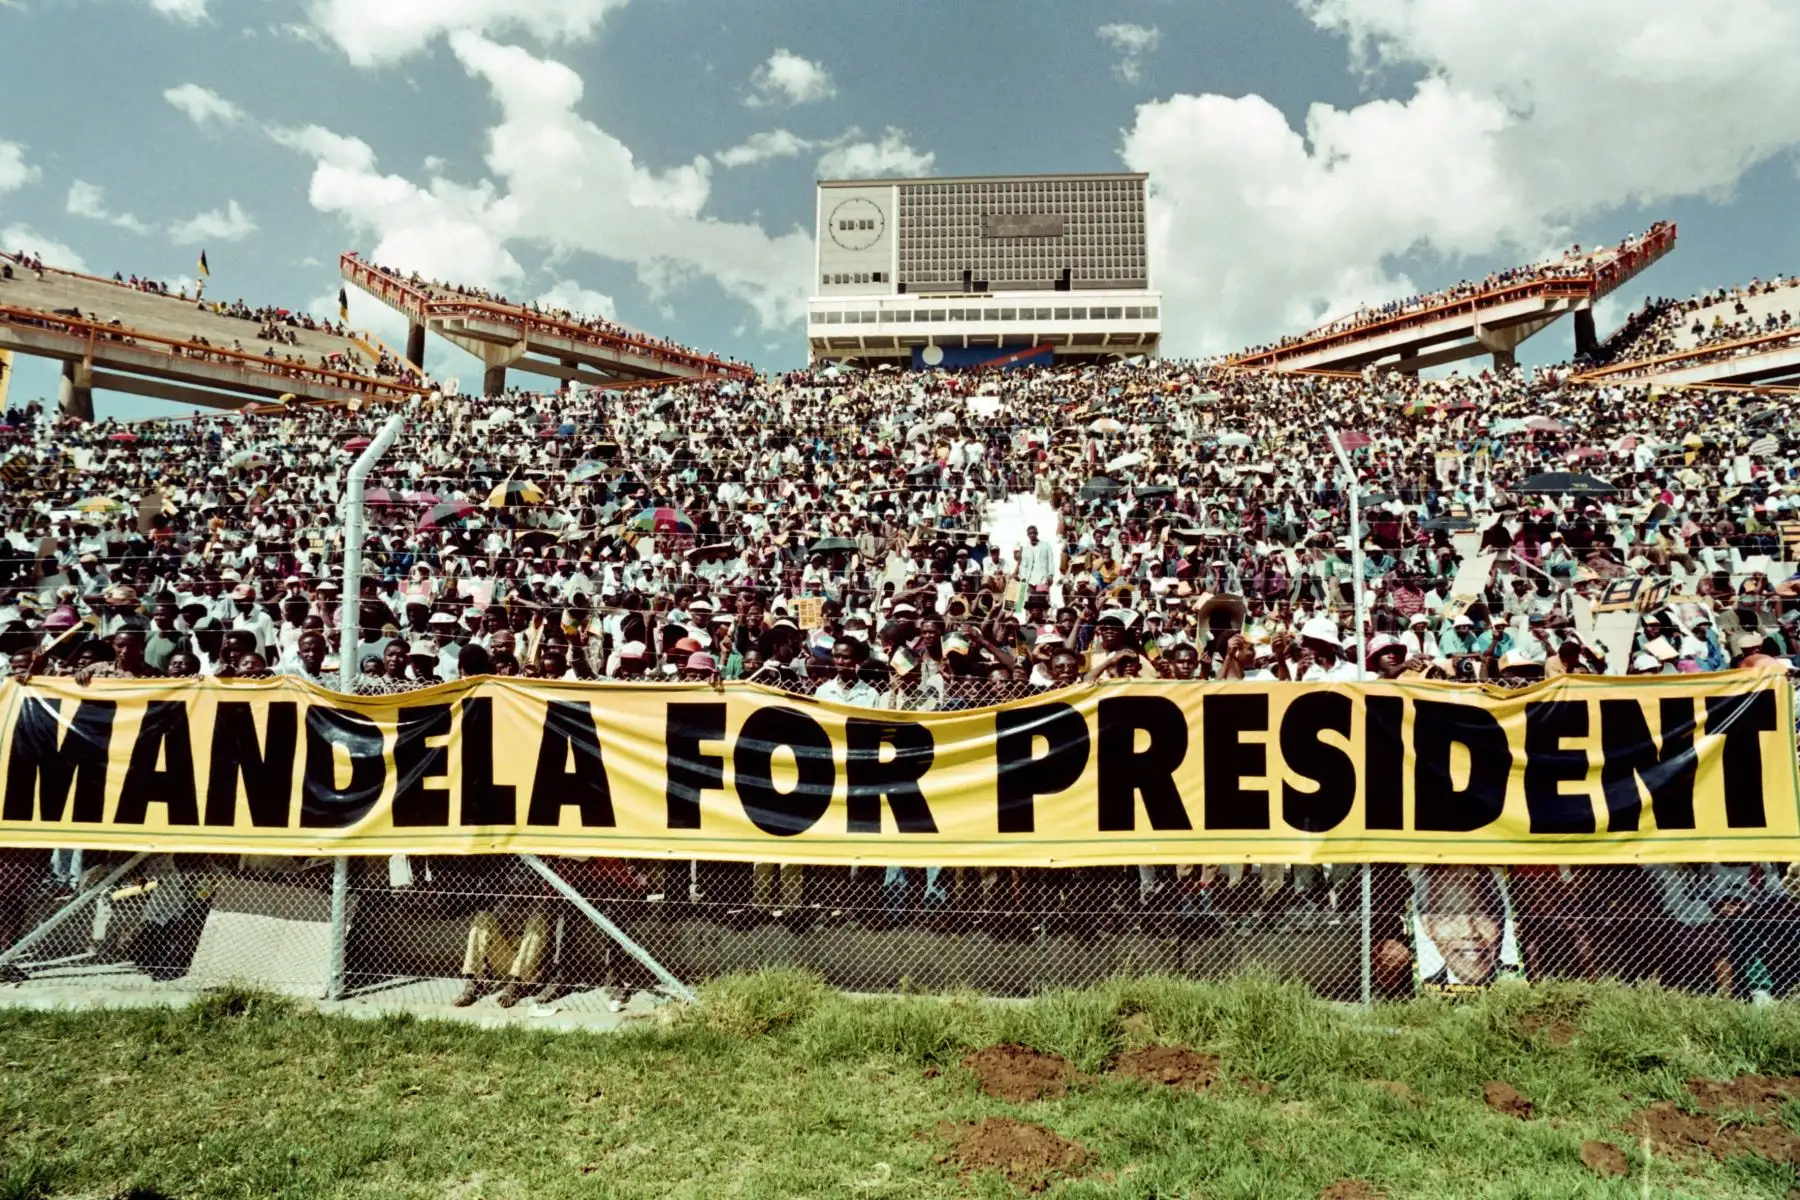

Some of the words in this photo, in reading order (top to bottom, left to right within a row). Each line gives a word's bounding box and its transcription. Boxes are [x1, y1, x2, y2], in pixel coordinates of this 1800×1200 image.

[3, 696, 617, 828] MANDELA
[665, 702, 939, 836] FOR
[994, 689, 1777, 833] PRESIDENT
